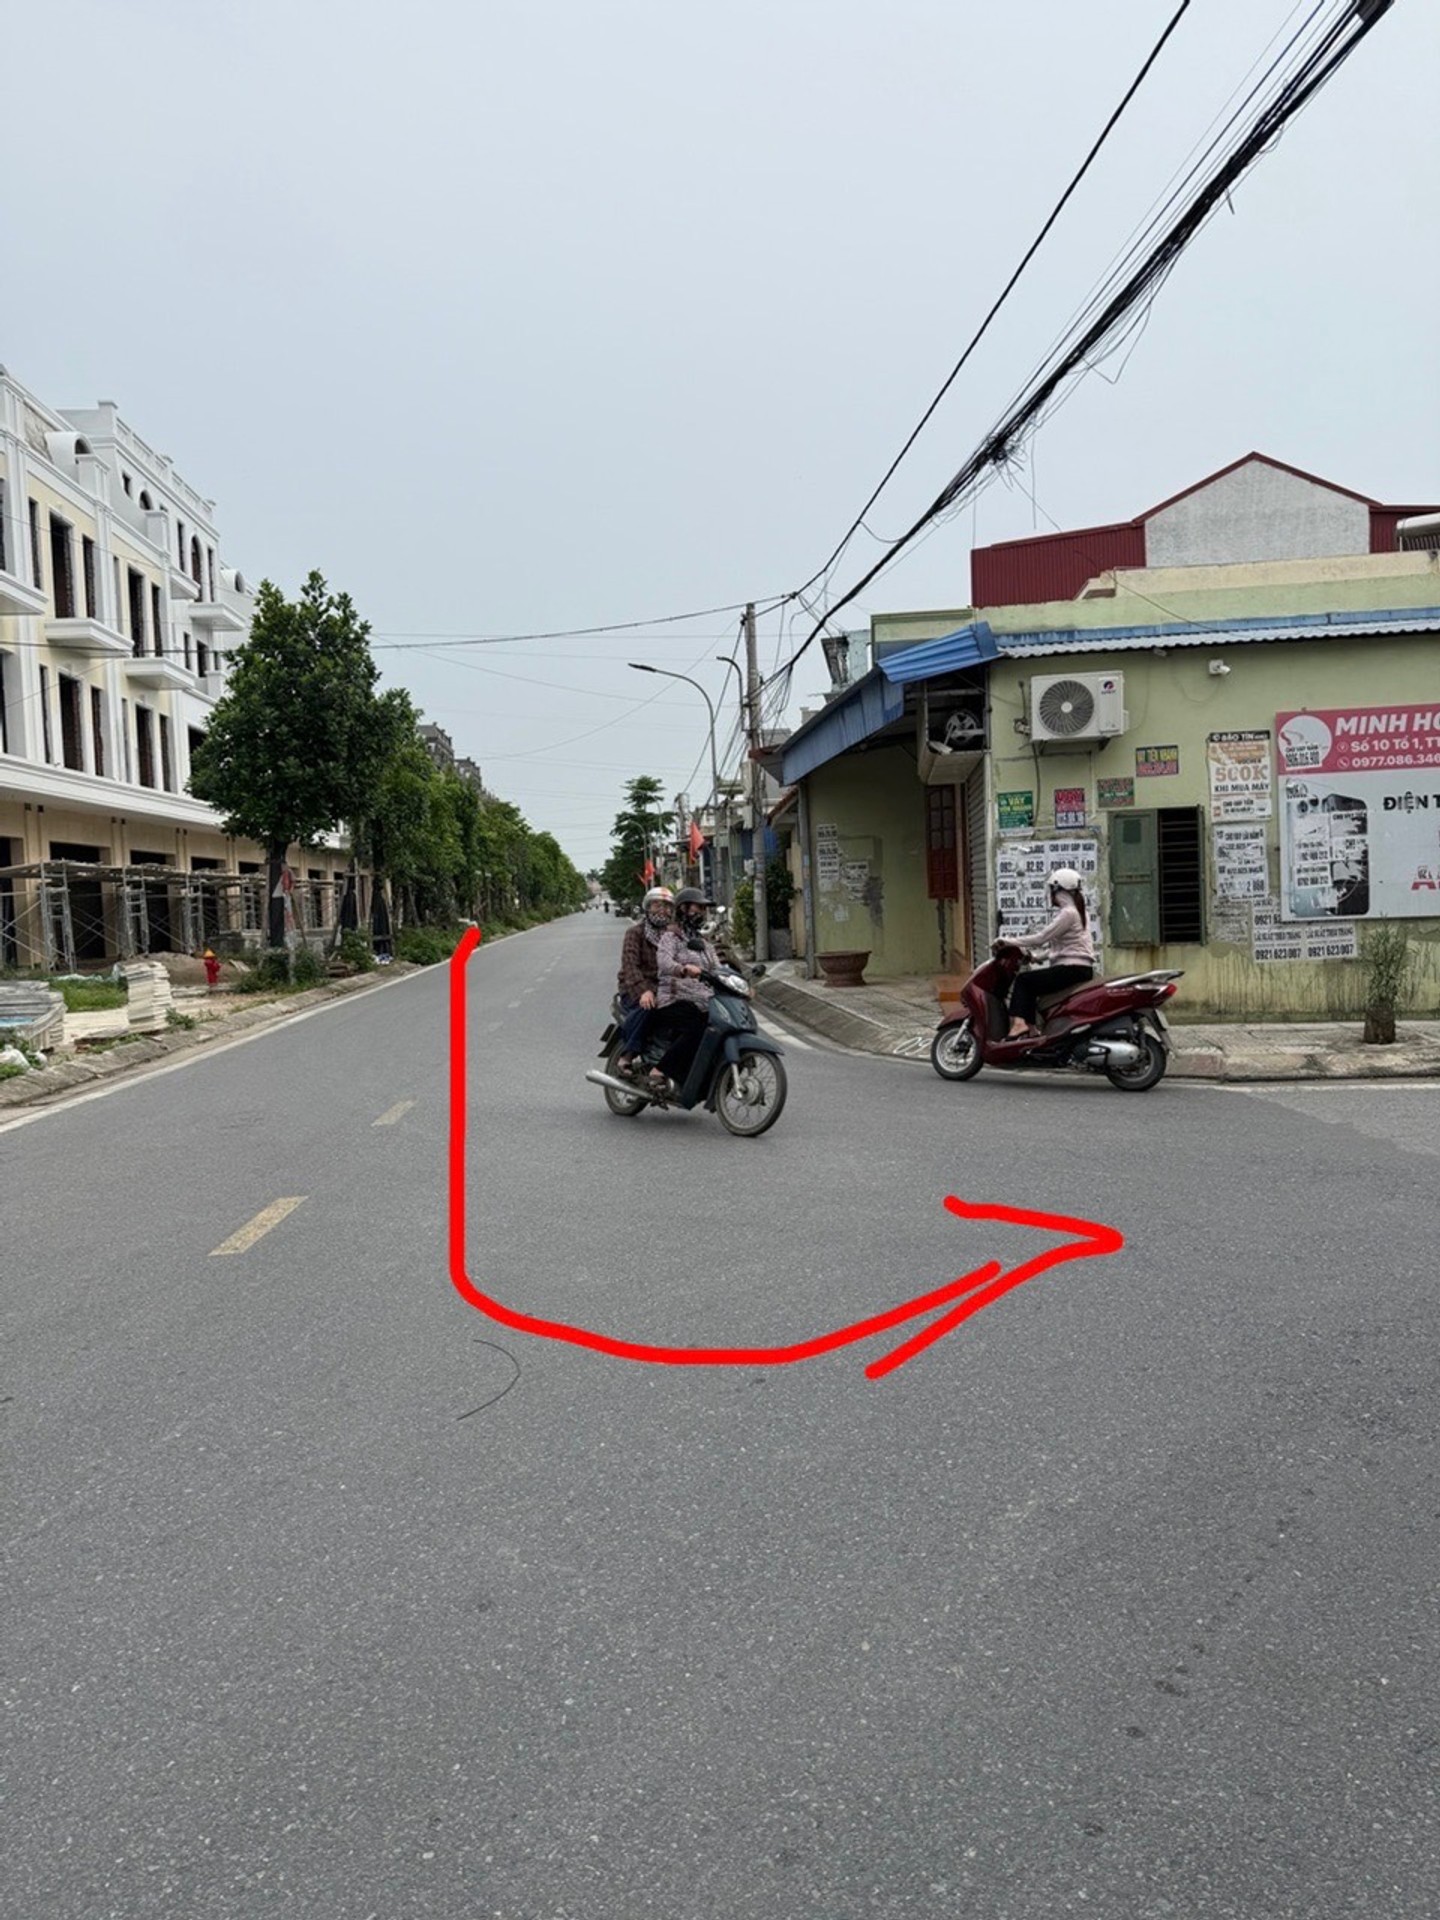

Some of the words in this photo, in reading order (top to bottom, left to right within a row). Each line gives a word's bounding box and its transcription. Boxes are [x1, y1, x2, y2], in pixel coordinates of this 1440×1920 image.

[1335, 713, 1408, 736] MINH
[1351, 737, 1369, 752] Số
[1372, 739, 1390, 751] 10
[1411, 738, 1424, 750] 1,
[1231, 784, 1250, 792] MUA
[1383, 791, 1428, 814] ĐIỆN
[1255, 949, 1272, 960] 0921
[1308, 946, 1325, 957] 0921
[1326, 944, 1339, 956] 623
